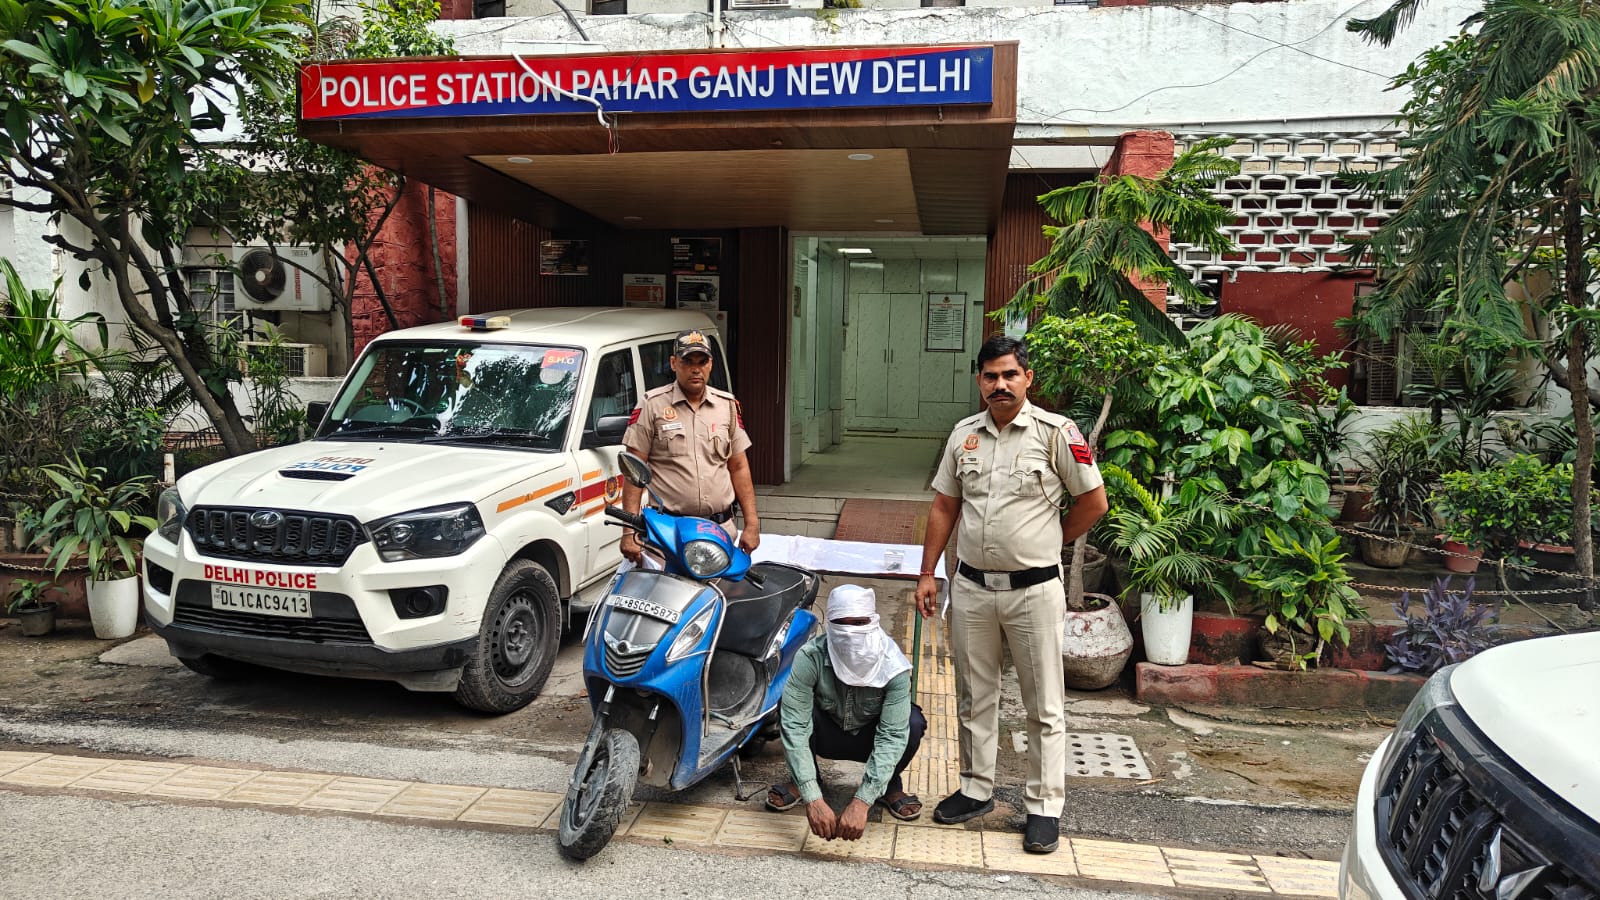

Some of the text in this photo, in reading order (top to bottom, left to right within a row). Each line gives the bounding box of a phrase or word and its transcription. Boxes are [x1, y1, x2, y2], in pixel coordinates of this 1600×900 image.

[320, 57, 971, 107] POLICE STATION PAHAR GANJ NEW DELHI
[204, 564, 317, 589] DELHI POLICE
[221, 589, 308, 613] DL1CAC9413
